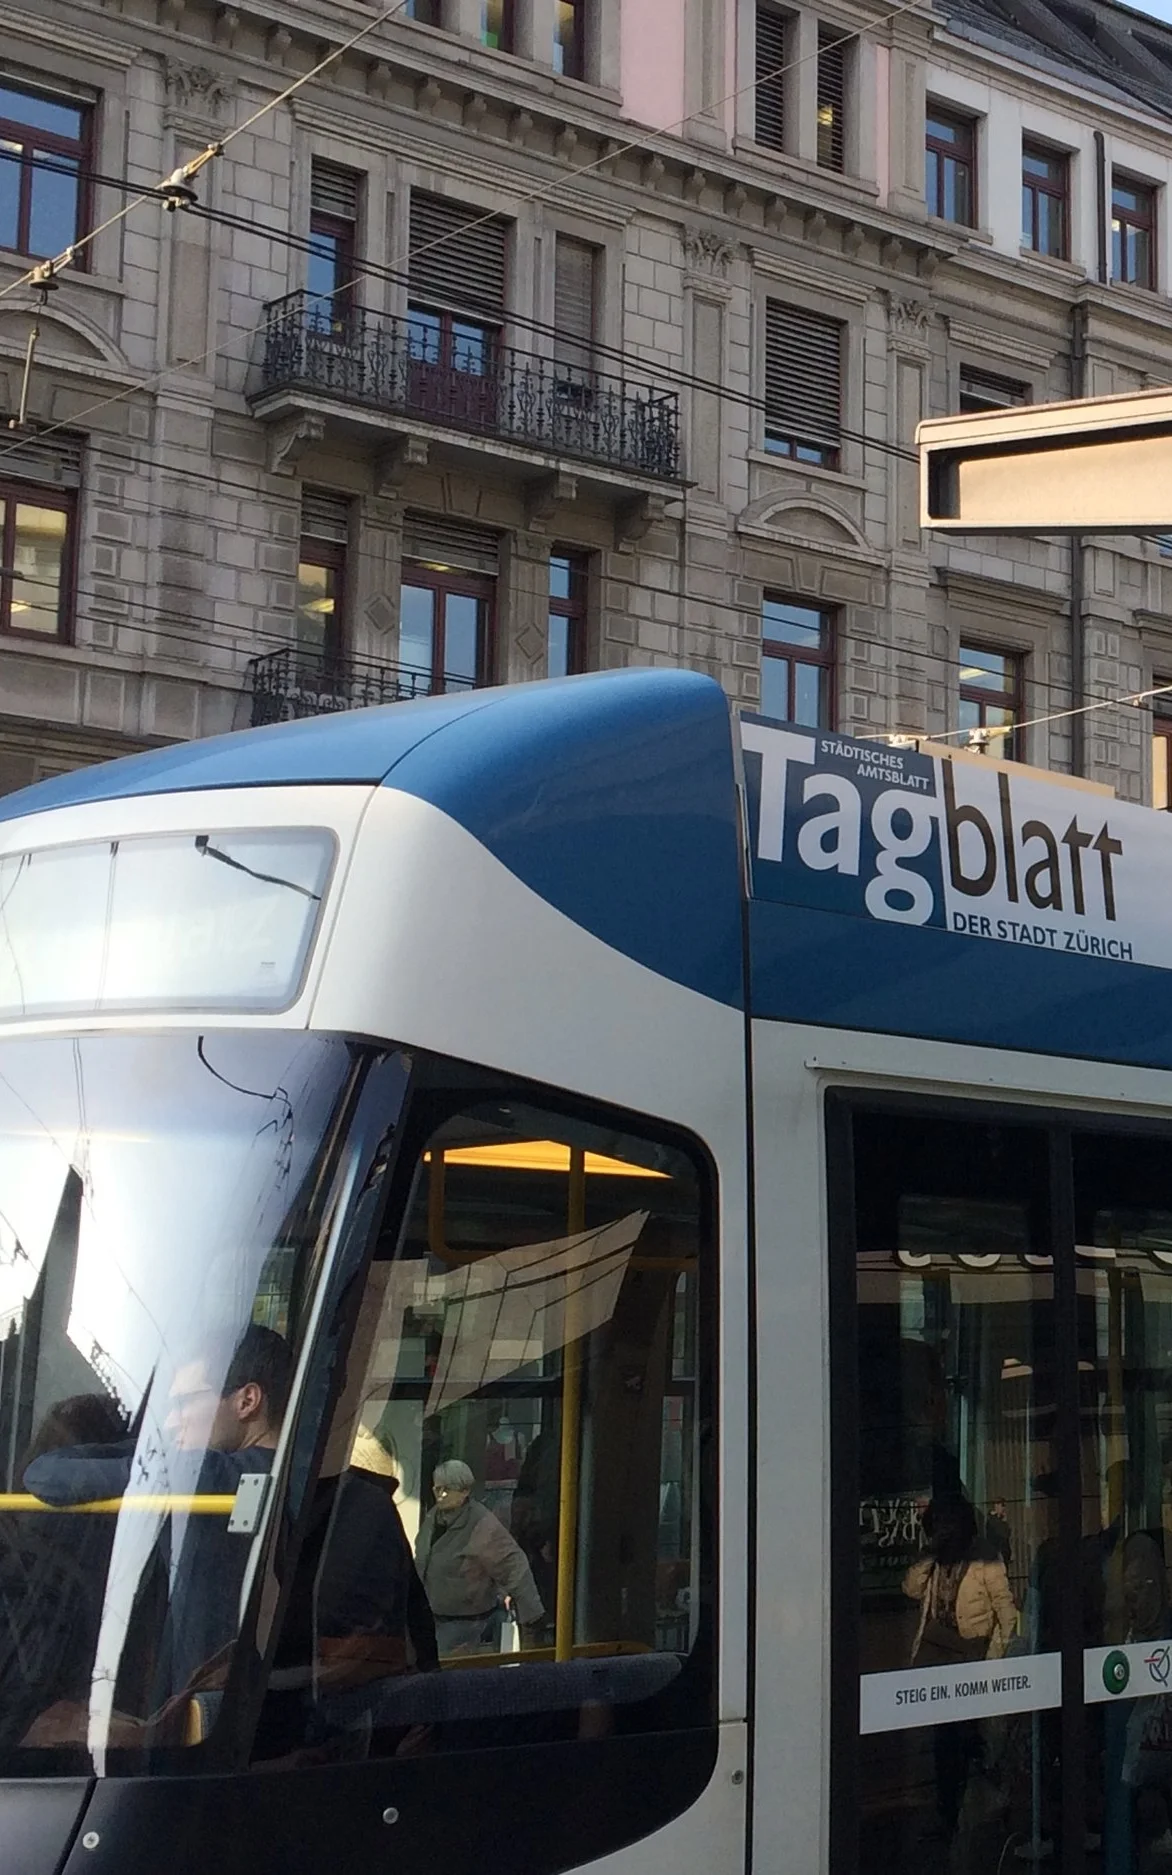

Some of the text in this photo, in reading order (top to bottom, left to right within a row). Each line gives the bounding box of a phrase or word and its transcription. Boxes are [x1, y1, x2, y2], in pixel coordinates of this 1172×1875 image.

[820, 739, 904, 770] STÄDTISCHES
[856, 764, 930, 791] AMTSBLATT
[740, 721, 1123, 927] Tagblatt
[953, 911, 1133, 961] DER STADT ZÜRICH
[895, 1675, 1032, 1706] STEIG EIN. KOMM WEITER.
